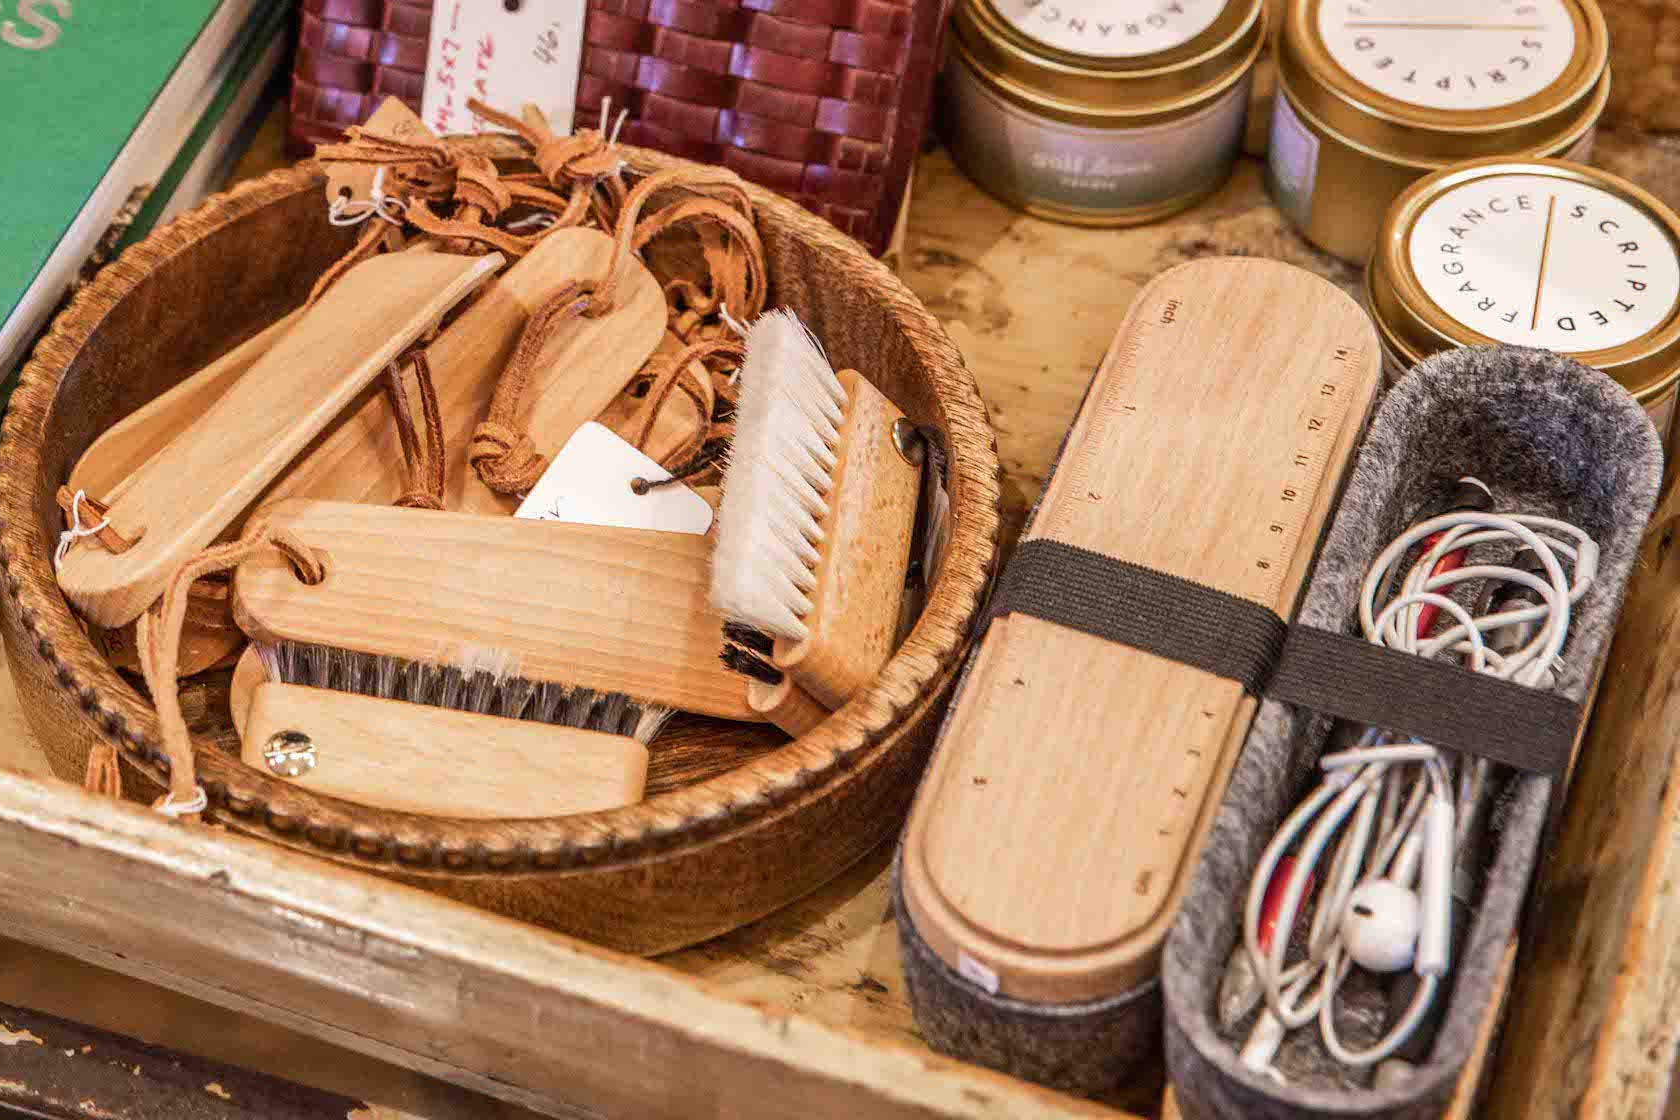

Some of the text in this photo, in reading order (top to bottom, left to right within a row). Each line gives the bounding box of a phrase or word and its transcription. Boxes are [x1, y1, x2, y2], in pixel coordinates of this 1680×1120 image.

[1439, 194, 1534, 323] FRAGRANCE
[1556, 203, 1648, 332] SCRIPTED
[1158, 298, 1184, 326] inch
[1332, 345, 1348, 363] 14
[1320, 383, 1336, 398] 13
[1306, 417, 1324, 432] 12
[1293, 454, 1310, 468] 11
[1280, 489, 1297, 503] 10
[1270, 523, 1283, 535] 9
[1256, 560, 1270, 571] 8
